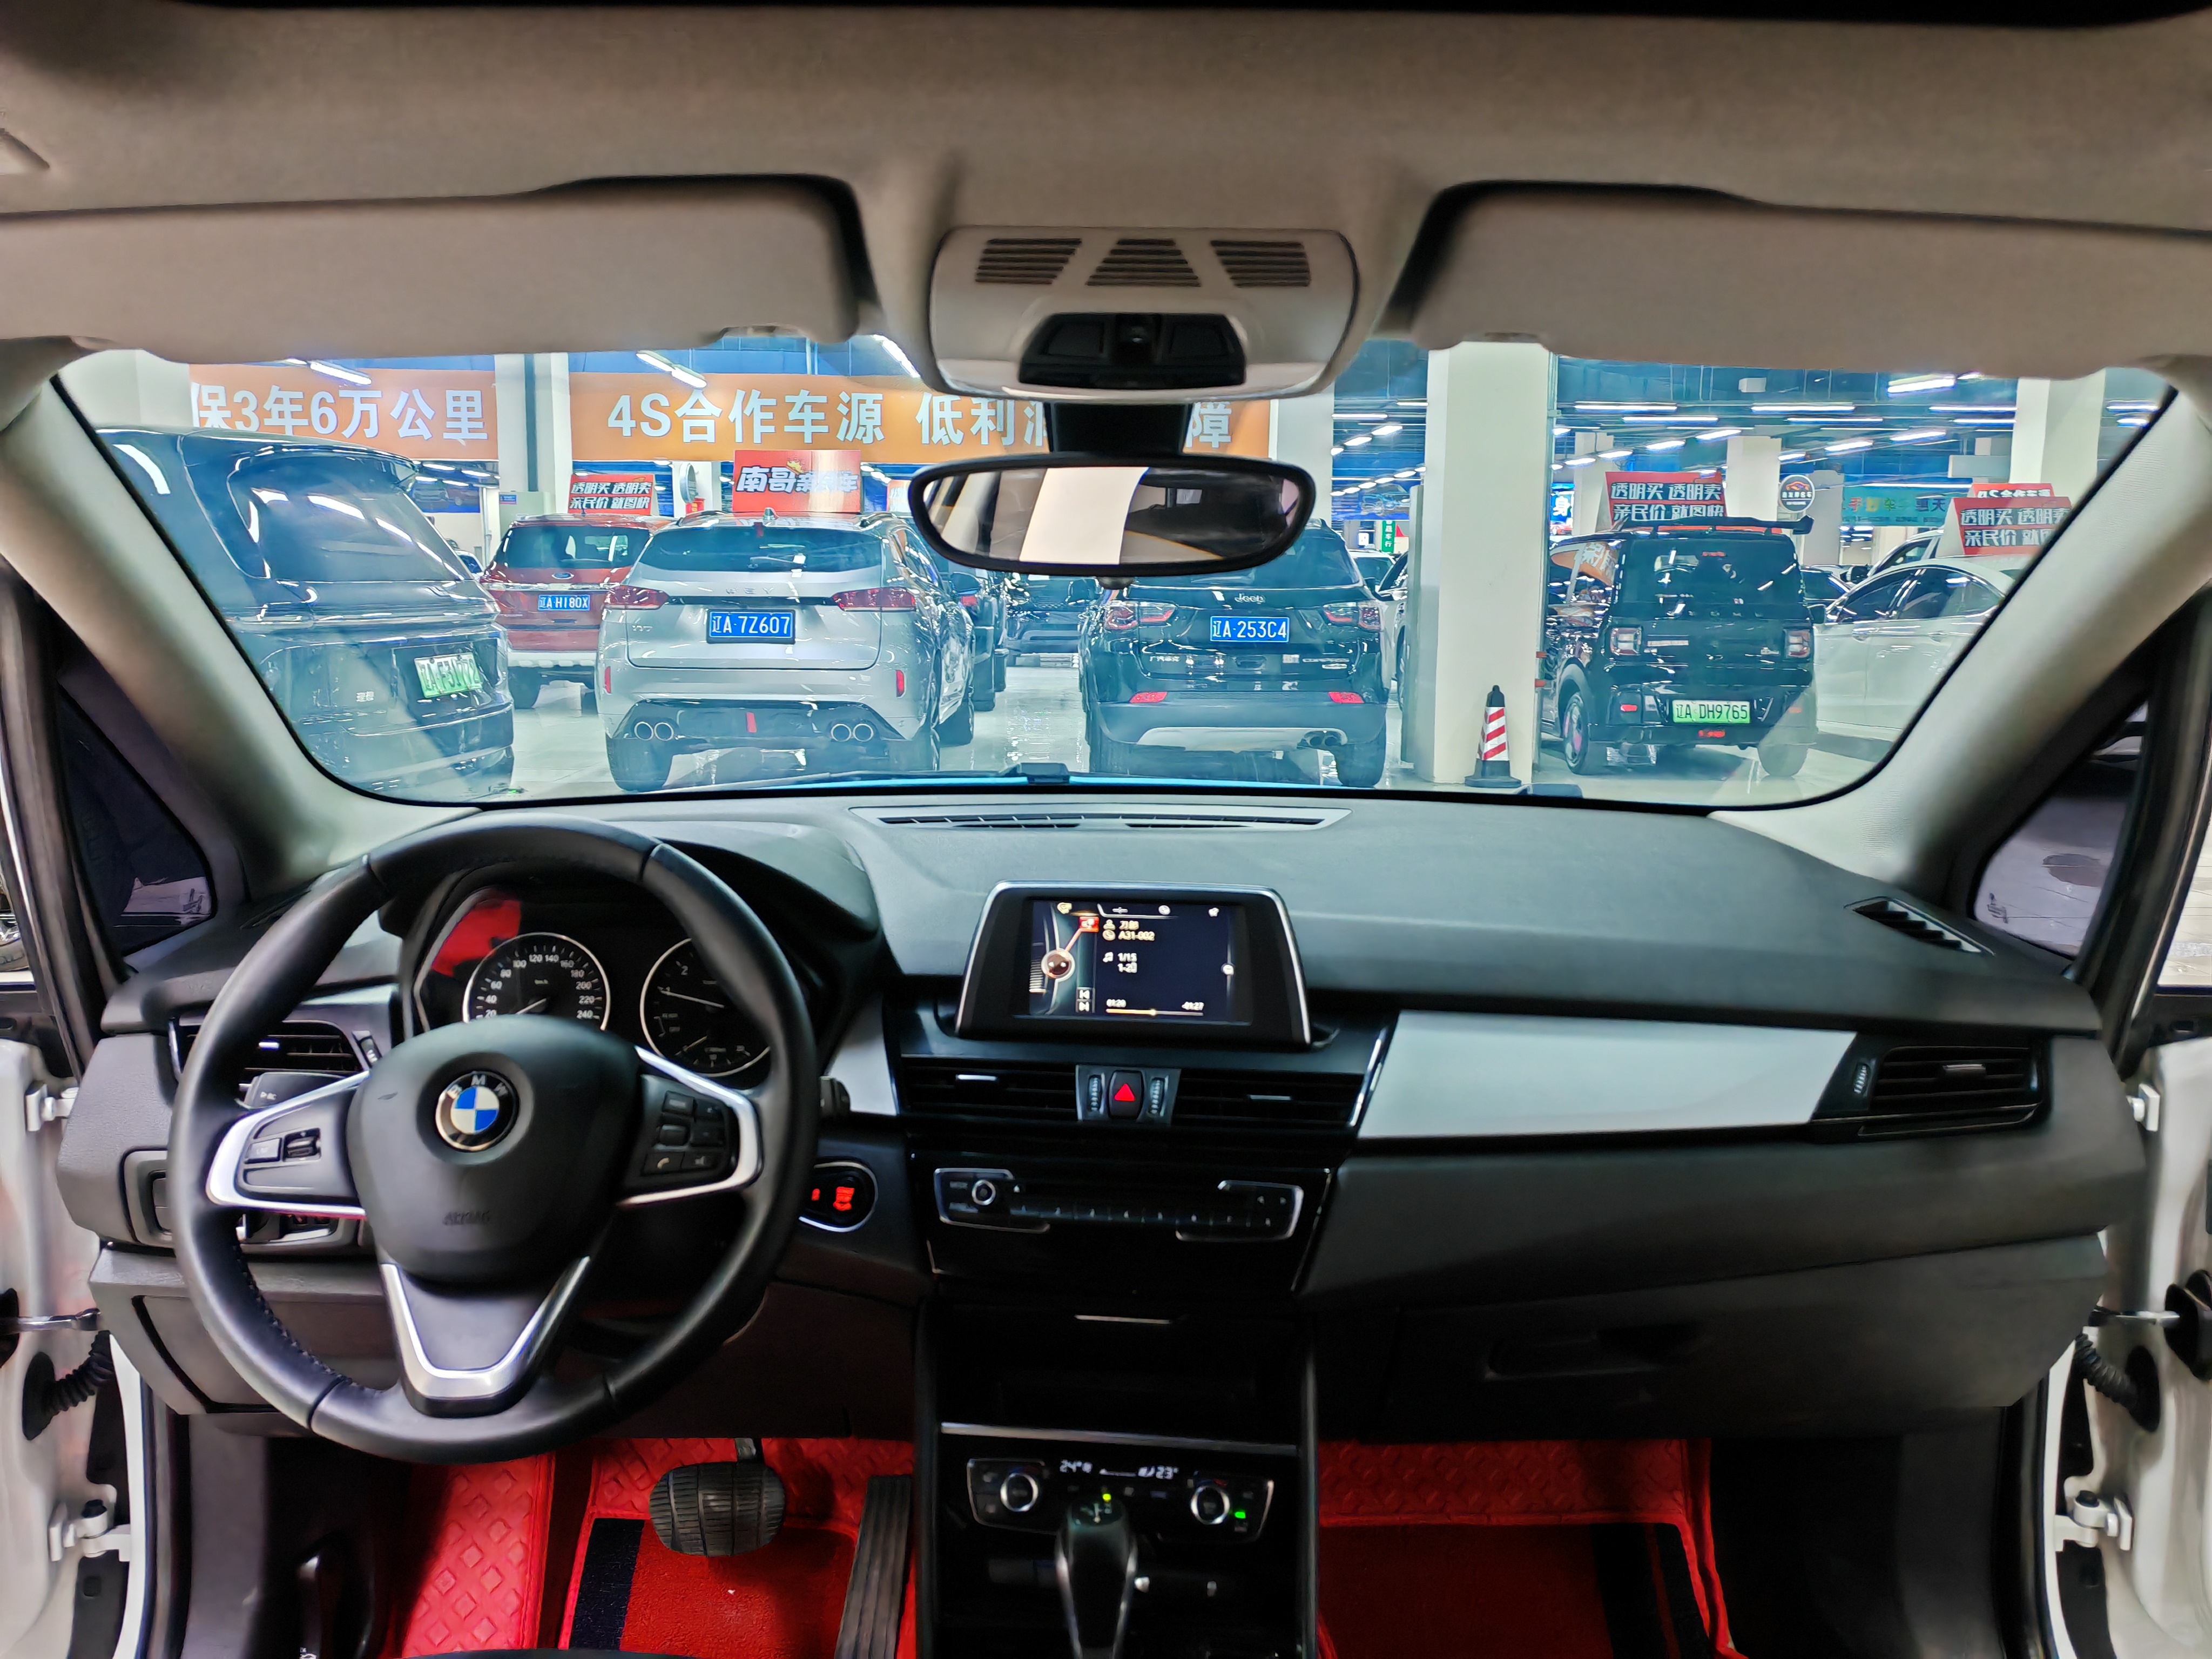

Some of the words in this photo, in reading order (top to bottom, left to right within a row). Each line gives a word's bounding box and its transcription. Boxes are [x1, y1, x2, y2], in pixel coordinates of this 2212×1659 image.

[608, 389, 885, 444] 4S合作车源
[571, 482, 611, 494] 透明买
[611, 482, 652, 494] 透明卖
[1610, 483, 1663, 500] 透明买
[1669, 483, 1722, 500] 透明卖
[569, 496, 609, 509] 亲民价
[1613, 504, 1666, 521] 亲民价
[1961, 509, 2013, 525] 透明买
[1965, 529, 2017, 546] 亲民价
[1234, 593, 1265, 603] Jeep
[529, 954, 543, 963] 120
[545, 954, 559, 962] 140
[513, 960, 527, 968] 100
[490, 981, 503, 990] 60
[576, 981, 592, 990] 200
[485, 995, 497, 1004] 40
[579, 995, 595, 1004] 220
[485, 1009, 497, 1019] 20
[577, 1010, 594, 1019] 240
